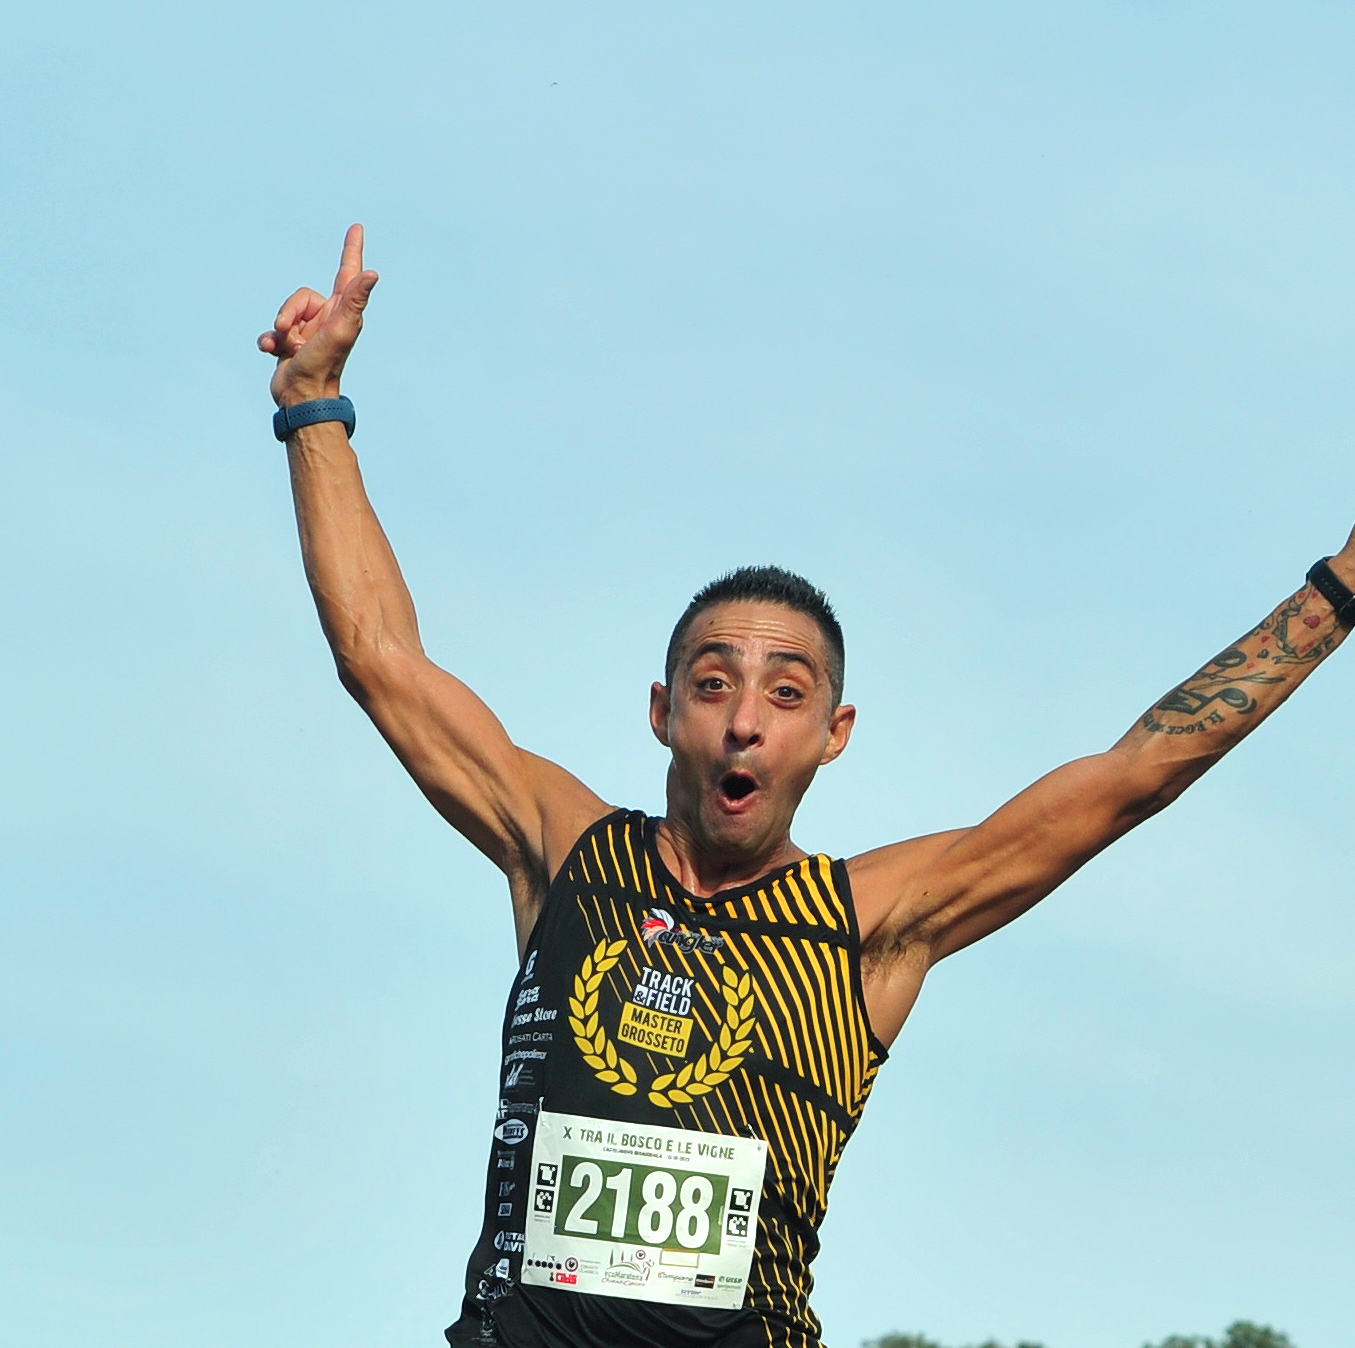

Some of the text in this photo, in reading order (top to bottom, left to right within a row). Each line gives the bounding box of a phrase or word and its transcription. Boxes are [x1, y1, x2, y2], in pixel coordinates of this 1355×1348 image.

[642, 966, 694, 997] TRACK
[533, 1007, 557, 1021] Store
[646, 989, 692, 1015] FIELD
[630, 1007, 683, 1035] MASTER
[621, 1023, 685, 1053] GROSSETO
[562, 1126, 573, 1140] X
[580, 1128, 603, 1144] TRA
[606, 1132, 617, 1145] IL
[621, 1133, 662, 1150] BOSCO
[666, 1140, 674, 1152] E
[677, 1141, 693, 1155] LE
[698, 1142, 736, 1160] VIGNE
[564, 1160, 714, 1249] 2188
